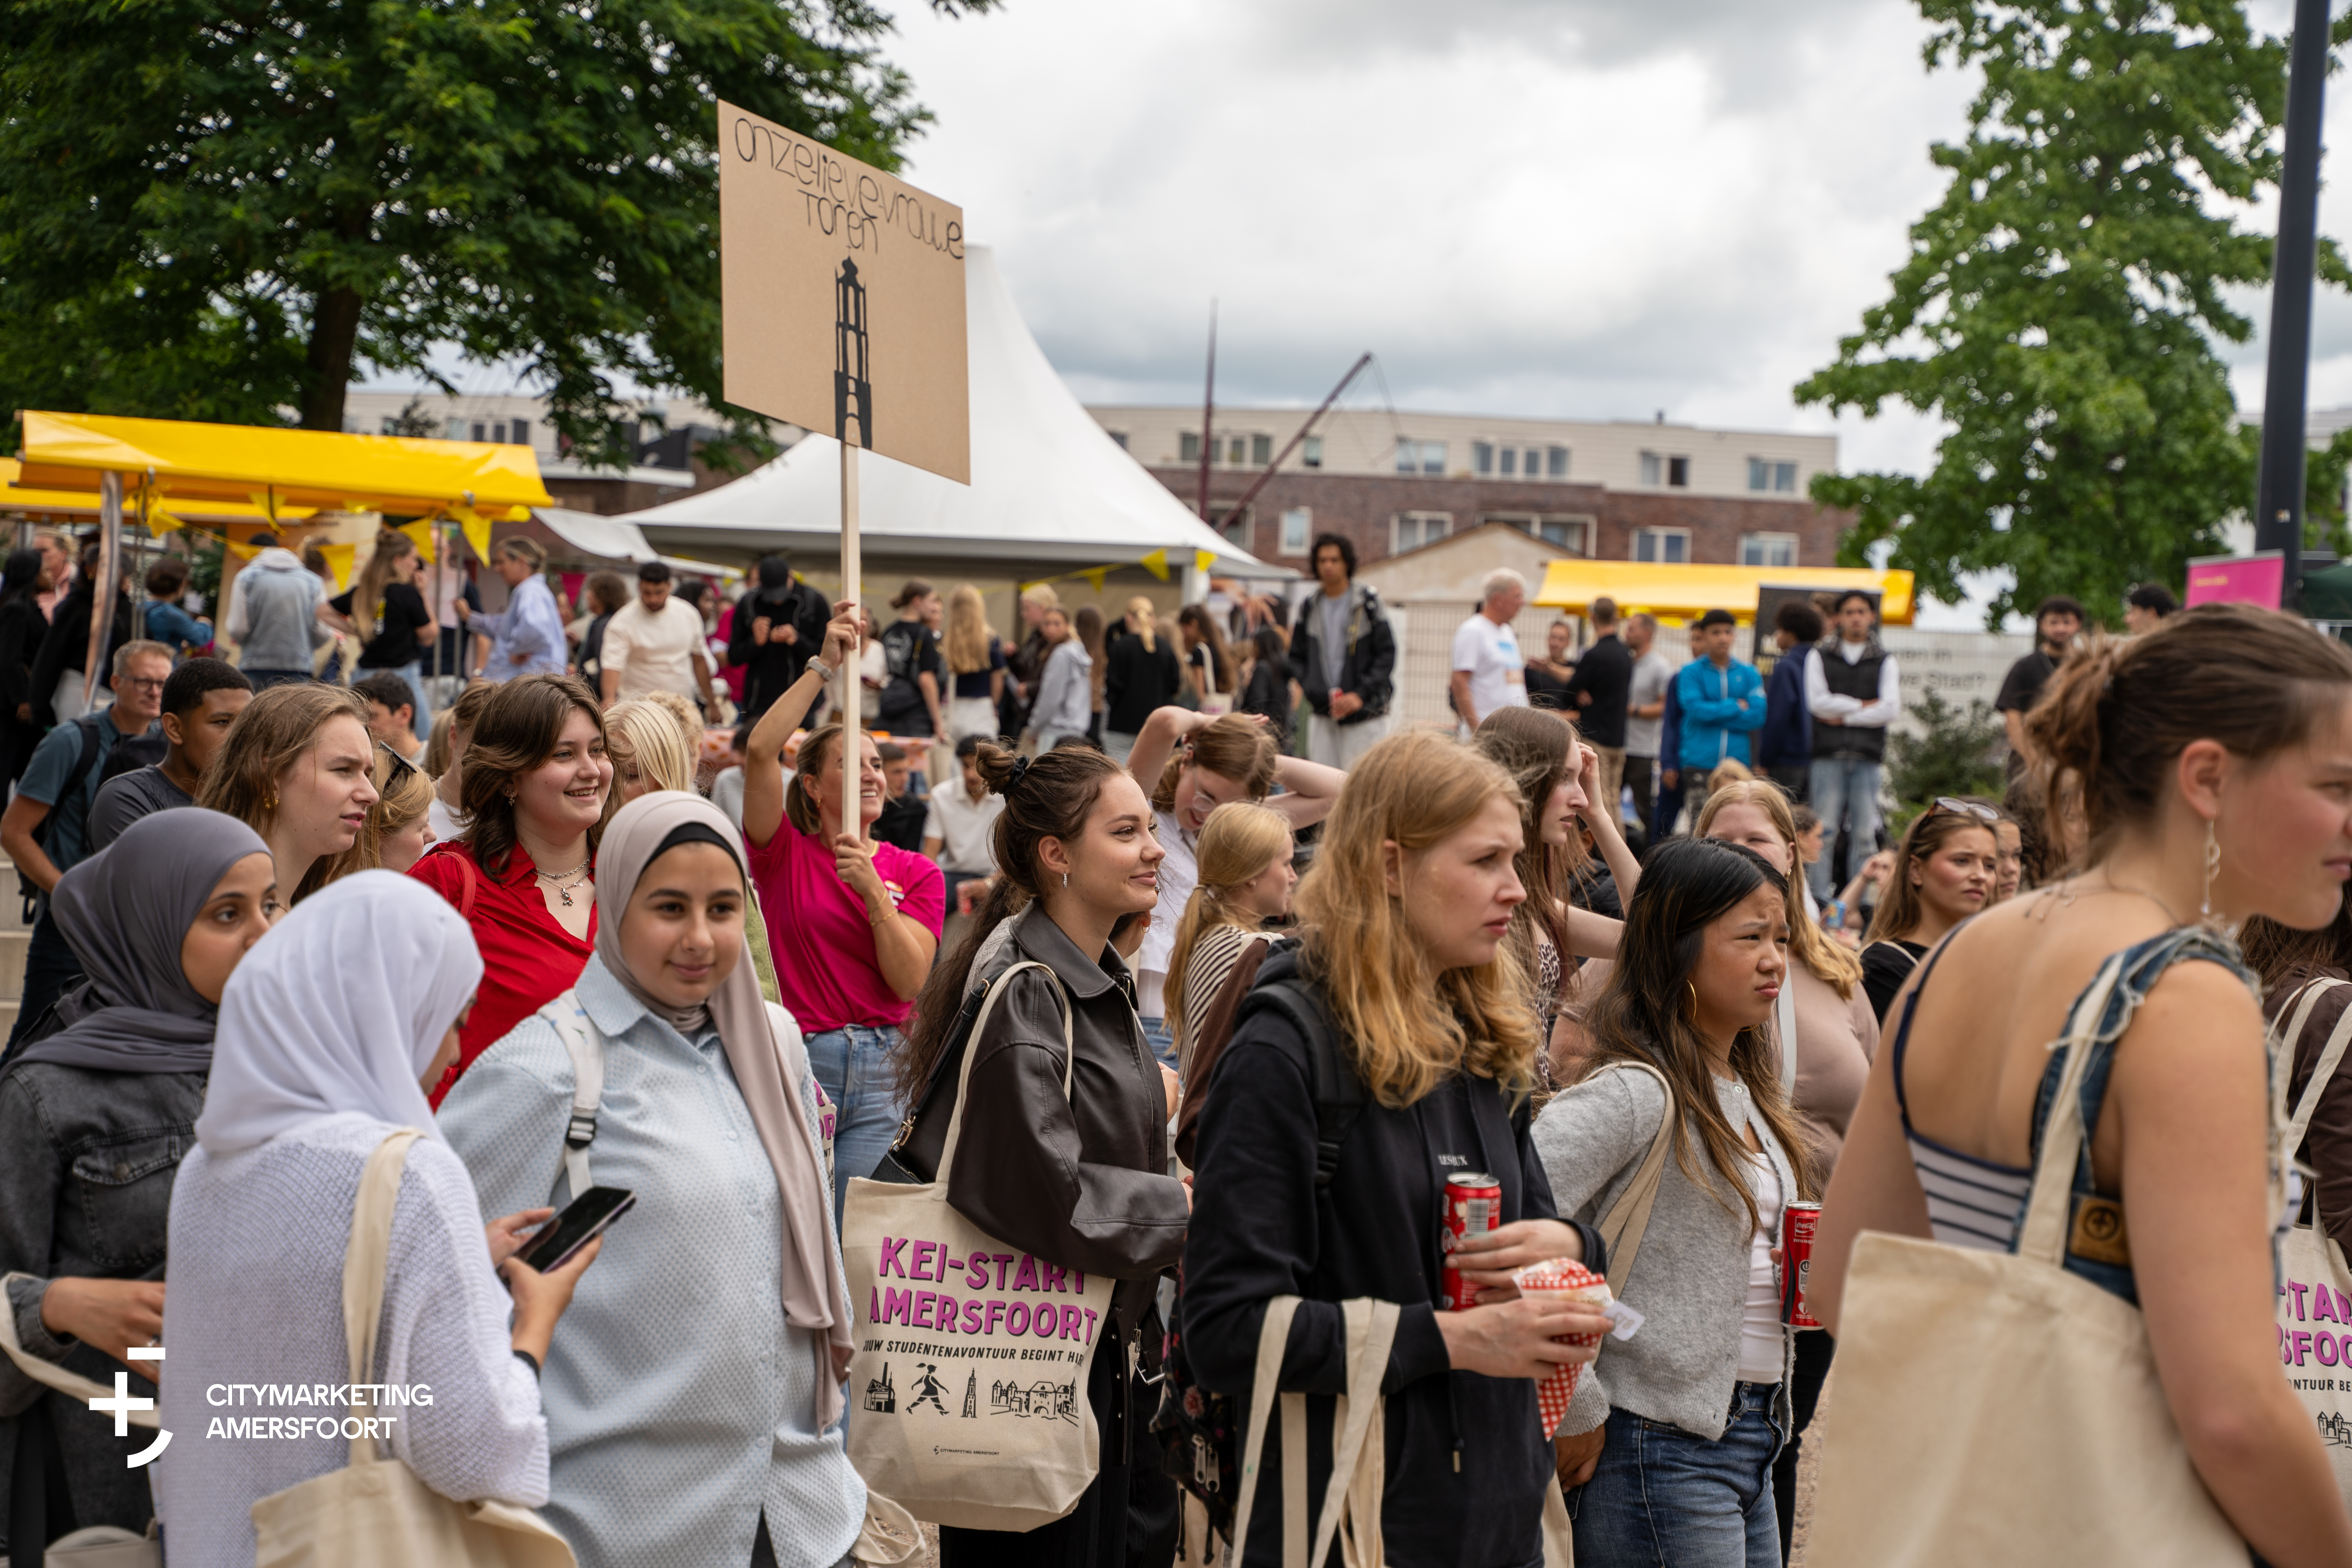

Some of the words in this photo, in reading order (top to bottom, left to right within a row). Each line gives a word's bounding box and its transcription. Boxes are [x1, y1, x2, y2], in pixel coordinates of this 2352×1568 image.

[869, 1285, 1097, 1346] AMERSFOORT
[863, 1339, 884, 1352] JOUW
[886, 1340, 1016, 1360] STUDENTENAVONTUUR
[1020, 1348, 1064, 1362] BEGINT
